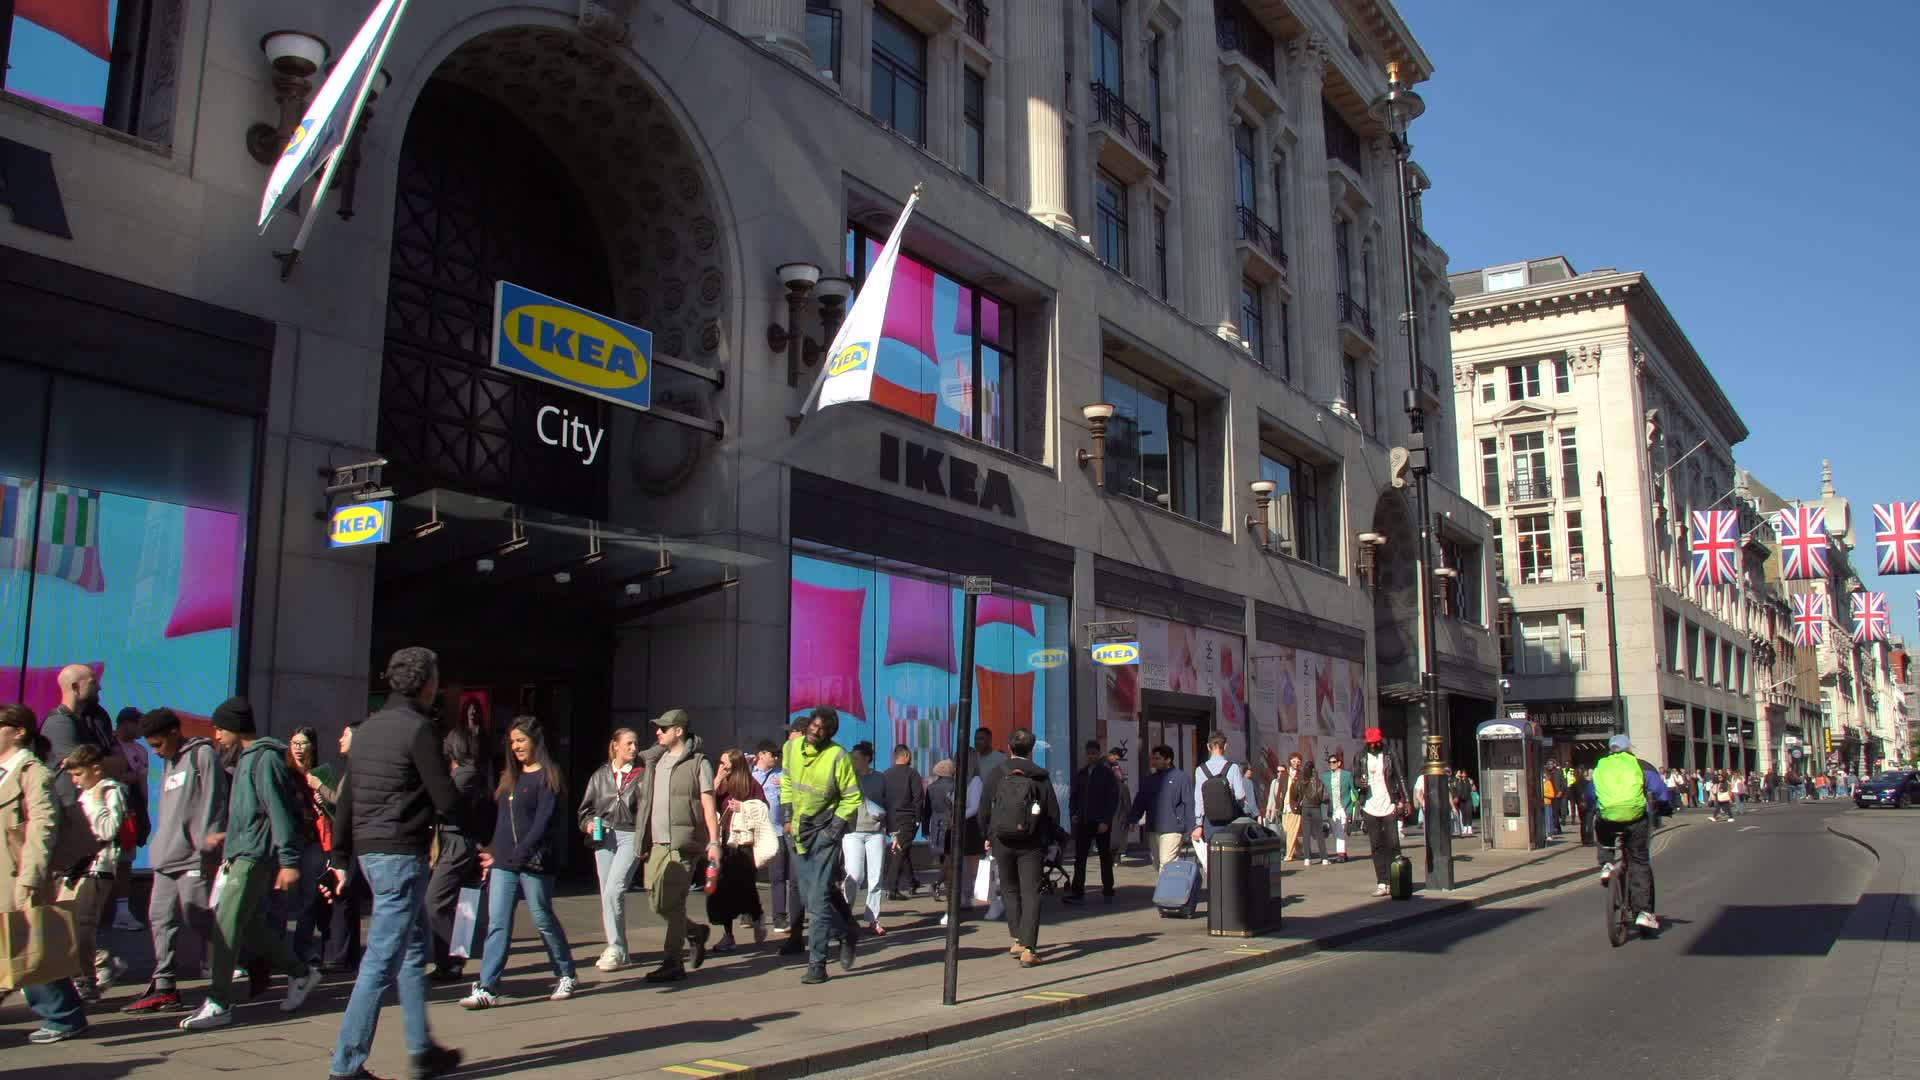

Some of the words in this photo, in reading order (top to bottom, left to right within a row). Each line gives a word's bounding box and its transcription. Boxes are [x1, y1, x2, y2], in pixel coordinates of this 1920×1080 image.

[517, 311, 638, 380] IKEA
[536, 405, 604, 465] City
[879, 431, 1016, 518] IKEA
[331, 515, 378, 534] IKEA
[1096, 649, 1134, 660] IKEA
